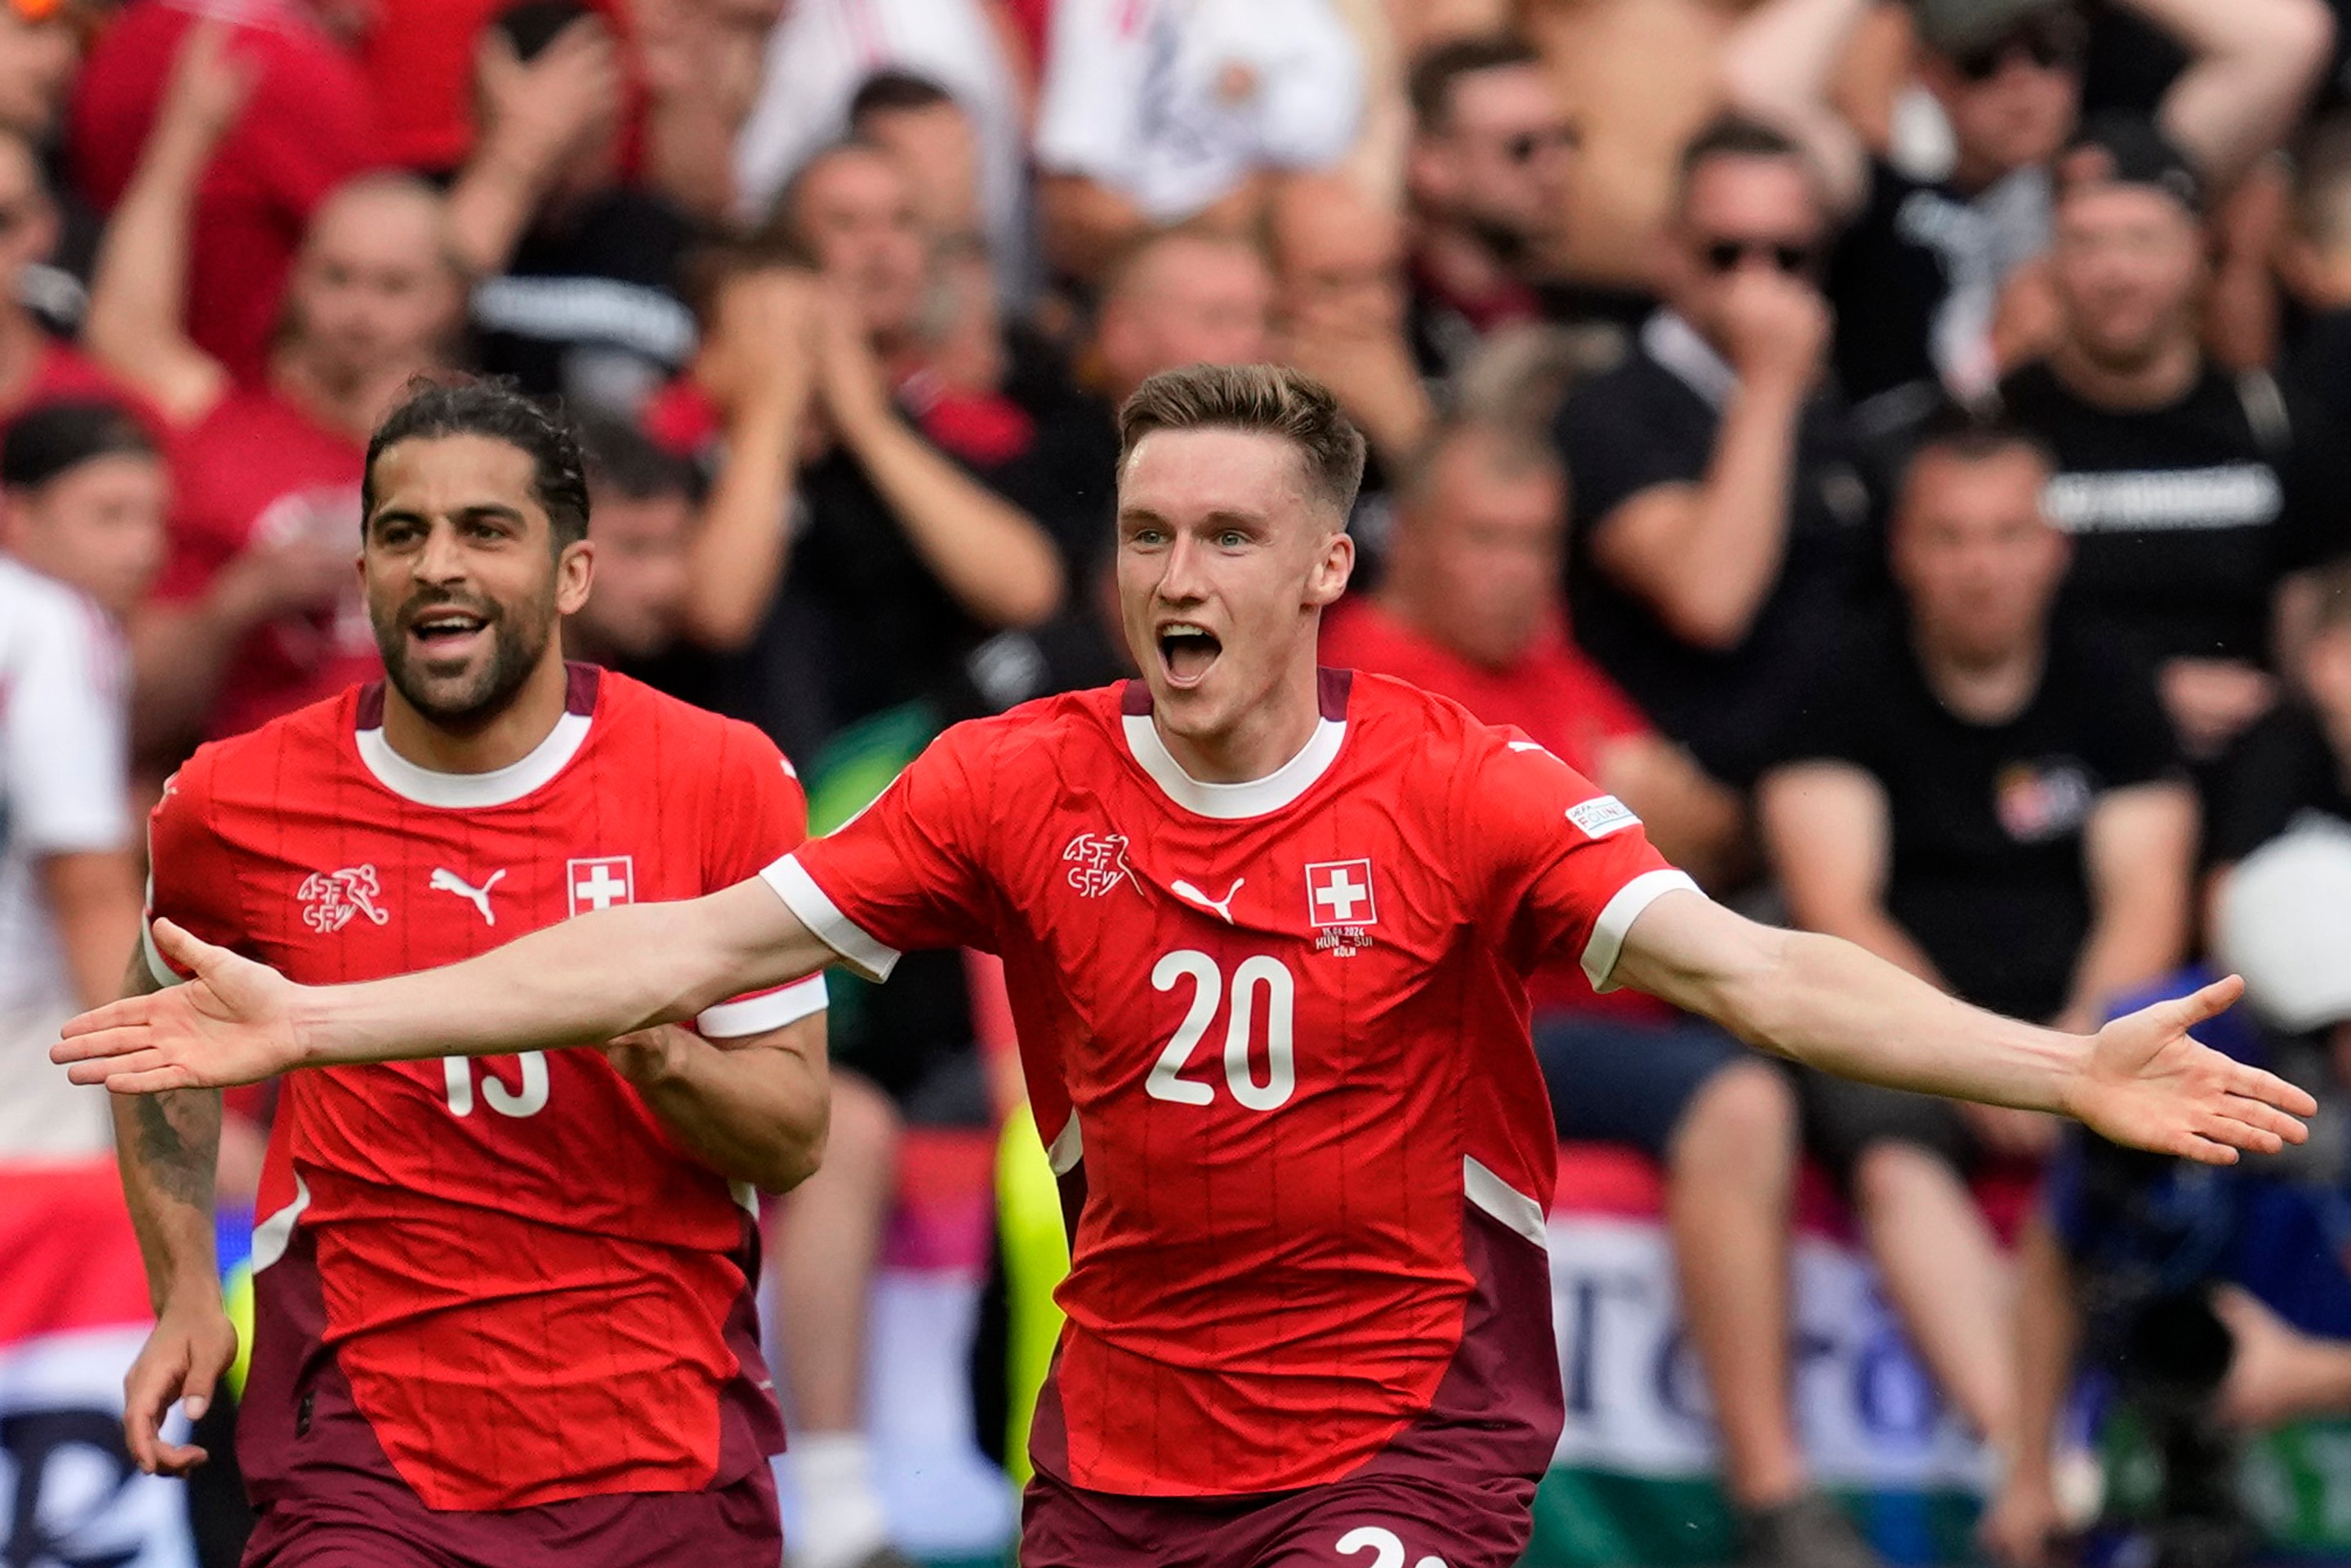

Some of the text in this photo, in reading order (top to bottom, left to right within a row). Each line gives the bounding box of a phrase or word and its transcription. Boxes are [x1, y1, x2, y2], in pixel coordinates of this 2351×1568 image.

[1316, 935, 1338, 949] HUN
[1354, 936, 1372, 947] SUI
[1334, 945, 1356, 957] KÖLN
[1146, 950, 1294, 1111] 20
